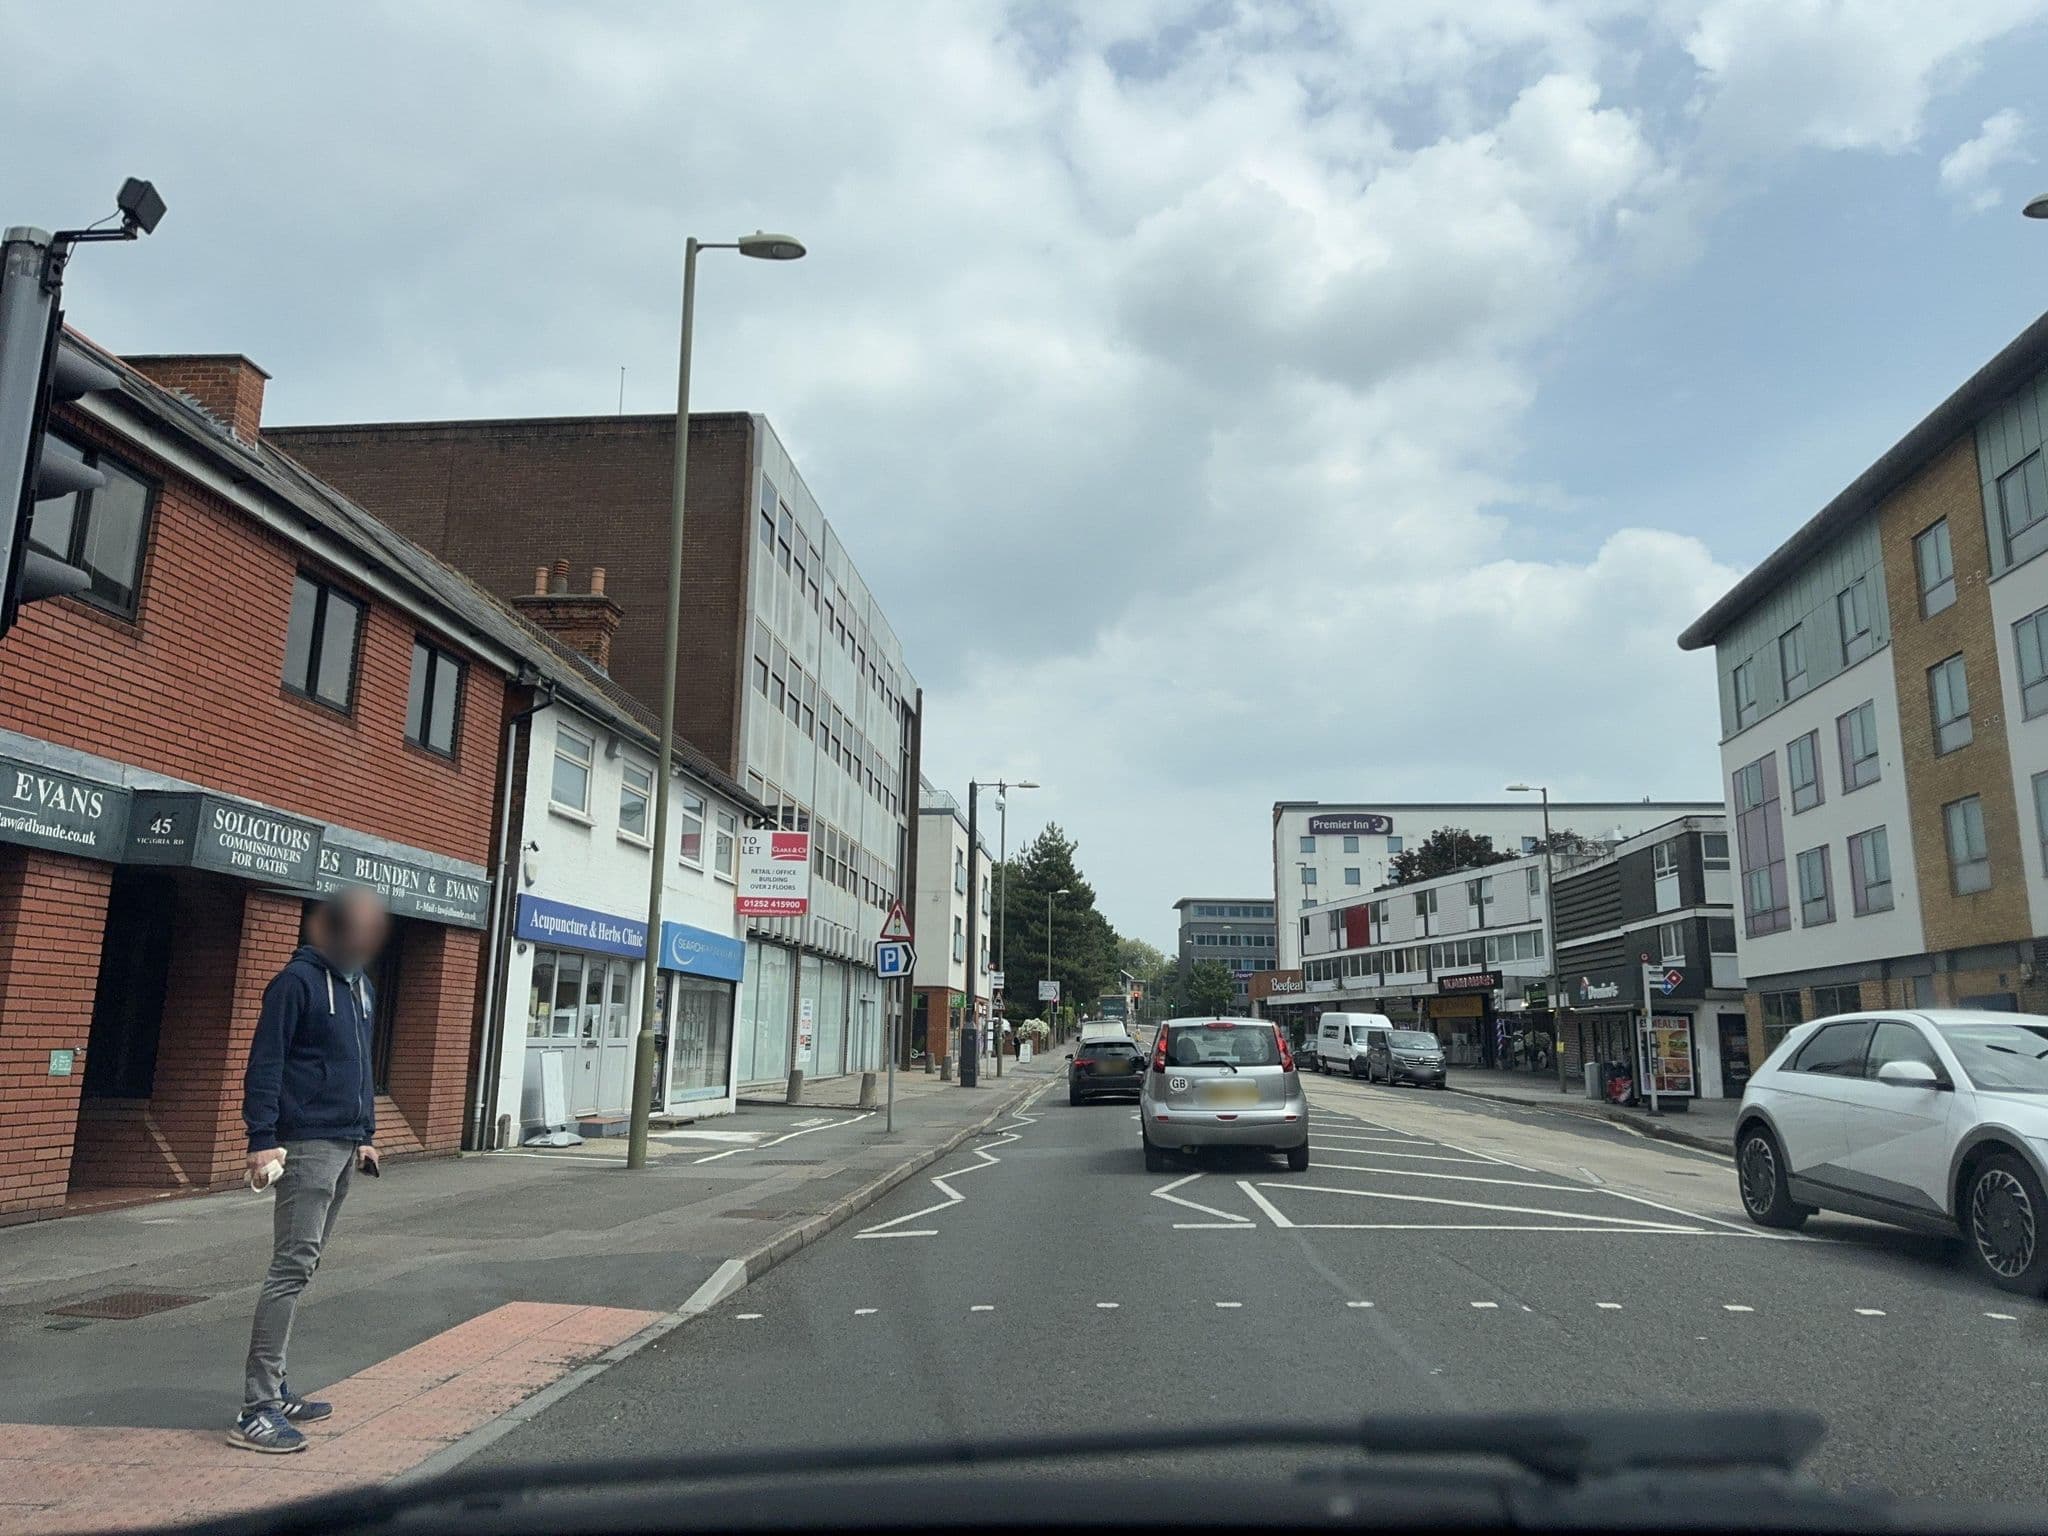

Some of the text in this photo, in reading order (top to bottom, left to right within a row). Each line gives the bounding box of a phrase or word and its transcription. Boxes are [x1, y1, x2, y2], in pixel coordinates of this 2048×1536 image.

[12, 771, 104, 818] EVANS
[150, 818, 173, 834] 45
[213, 808, 311, 851] SOLICITORS
[1313, 820, 1369, 829] Premier Inn
[219, 833, 301, 863] COMMISSIONERS
[742, 836, 757, 845] TO
[742, 846, 761, 855] LET
[231, 851, 288, 875] FOR OATHS
[354, 857, 420, 889] BLUNDEN
[427, 876, 436, 894] &
[445, 879, 480, 903] EVANS
[376, 882, 389, 895] EST
[743, 899, 800, 908] 01252 415900
[530, 909, 643, 948] Acupuncture & Herbs Clinic
[884, 950, 896, 970] P
[1172, 1079, 1186, 1089] GB
